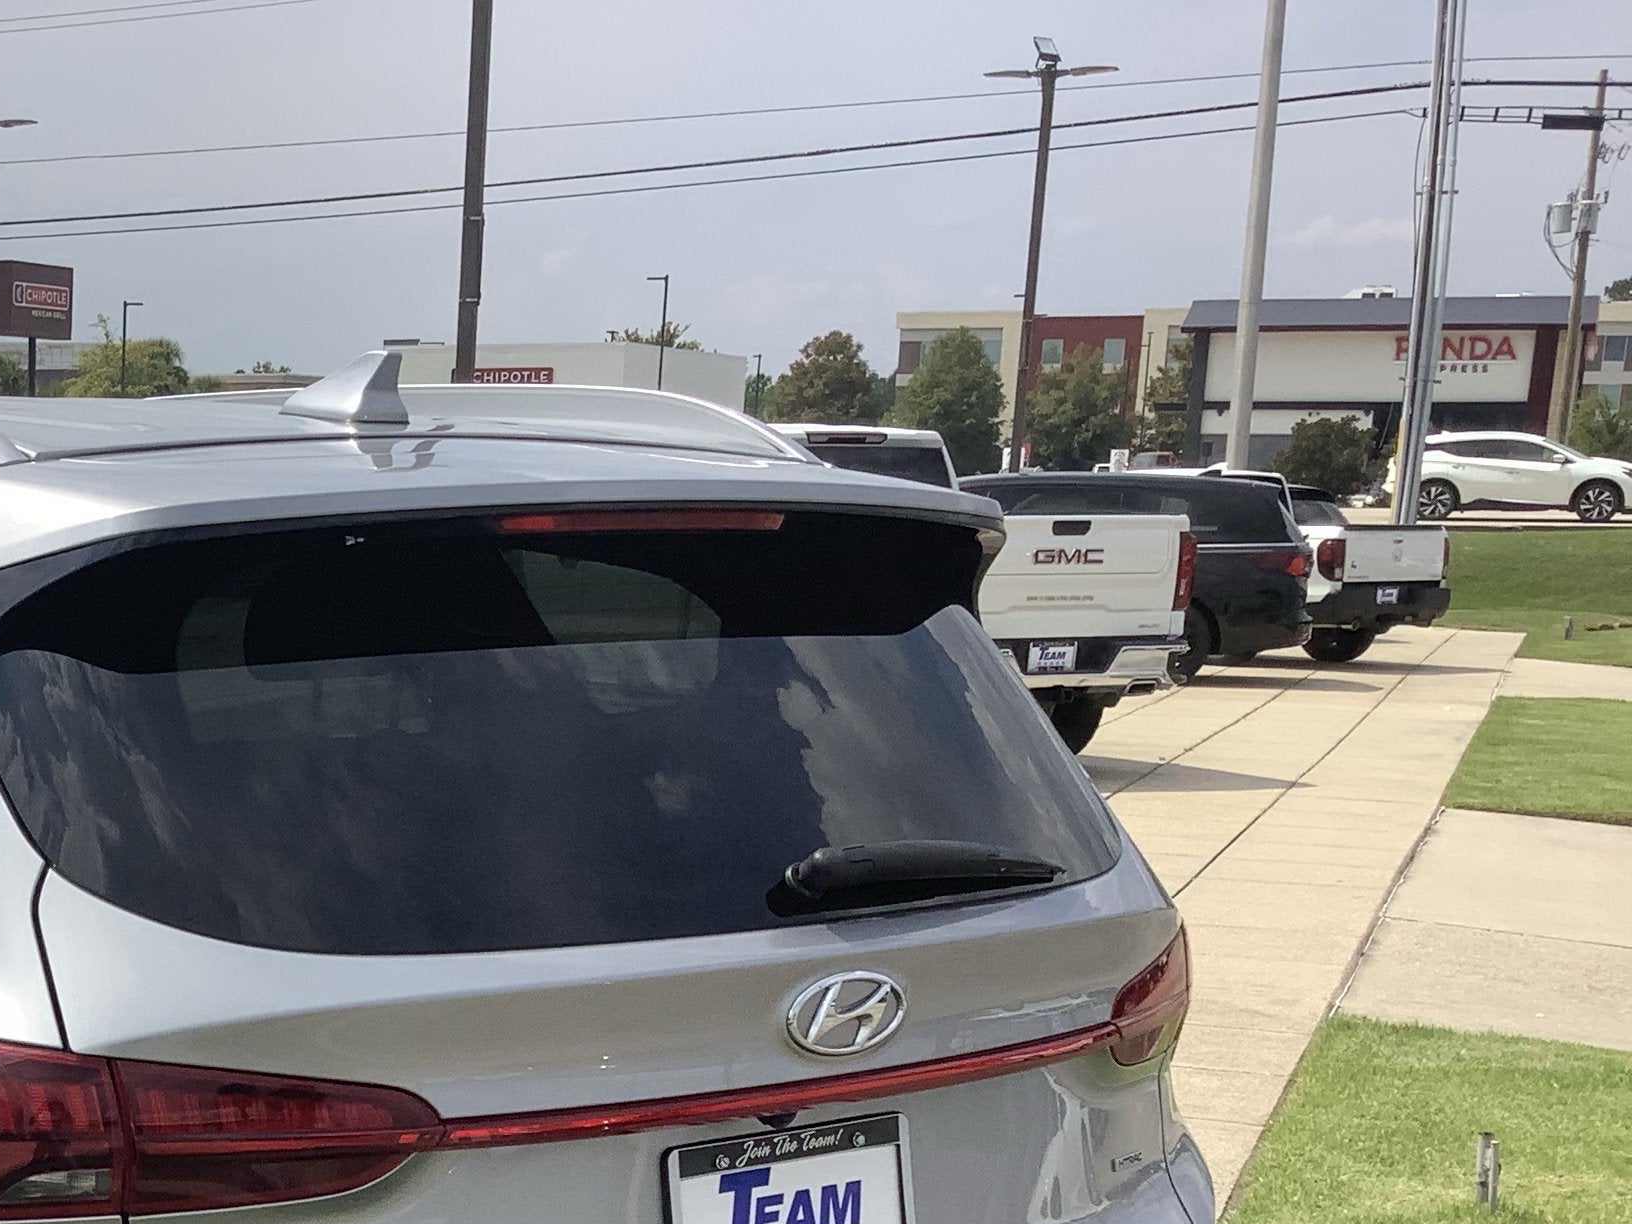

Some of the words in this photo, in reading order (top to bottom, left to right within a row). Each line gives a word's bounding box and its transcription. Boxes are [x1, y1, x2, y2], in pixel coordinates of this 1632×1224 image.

[26, 289, 67, 305] CHIPOTLE
[1395, 335, 1516, 361] PNDA
[1439, 364, 1489, 373] PRESS
[472, 371, 549, 383] CHIPOTLE
[1033, 549, 1104, 565] GMC
[736, 1140, 771, 1168] Join
